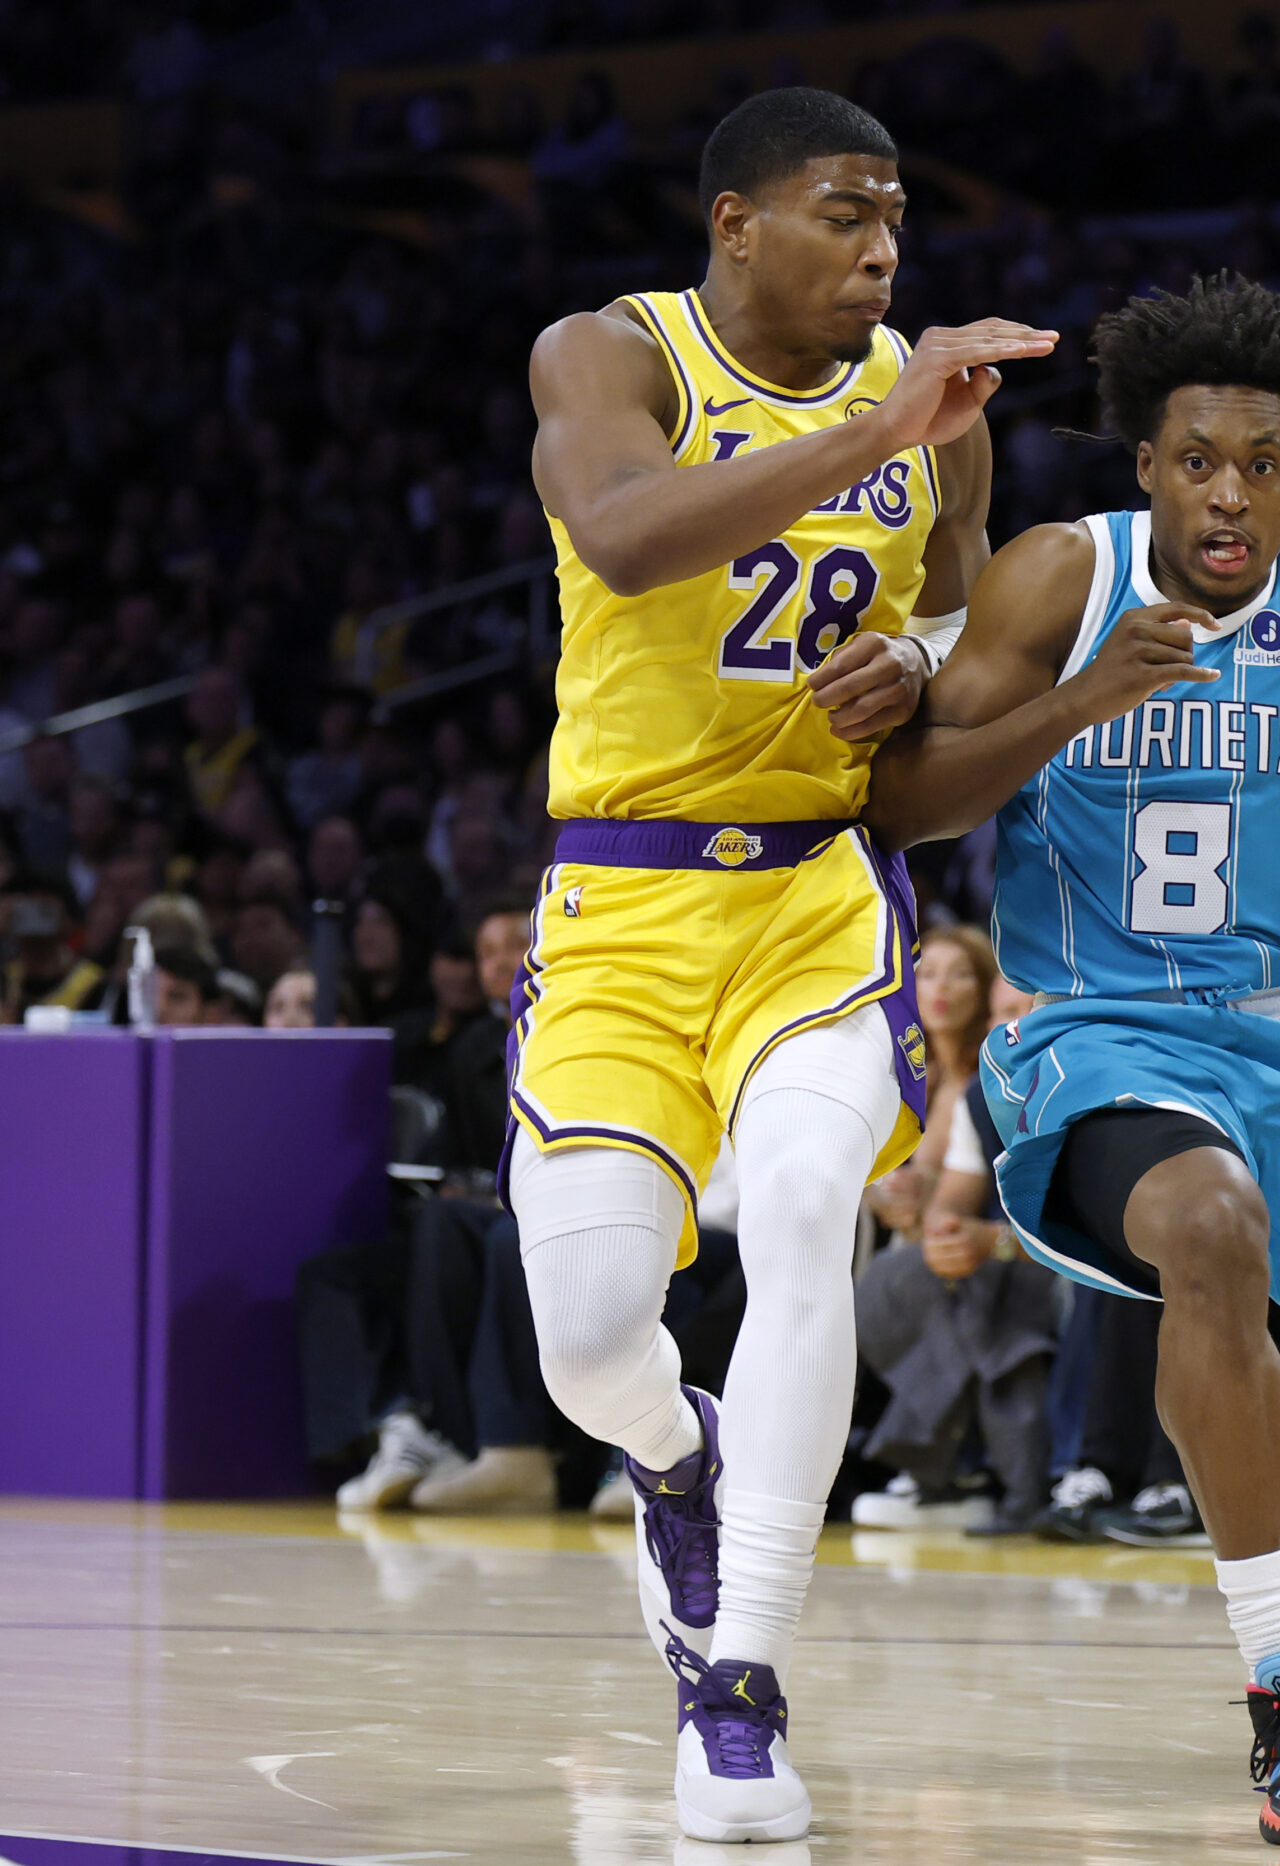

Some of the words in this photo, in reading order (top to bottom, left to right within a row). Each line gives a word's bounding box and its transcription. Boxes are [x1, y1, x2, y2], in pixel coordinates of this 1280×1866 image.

[718, 538, 881, 683] 28
[1236, 651, 1265, 664] Judi
[704, 837, 762, 858] LAKERS
[1129, 799, 1233, 934] 8
